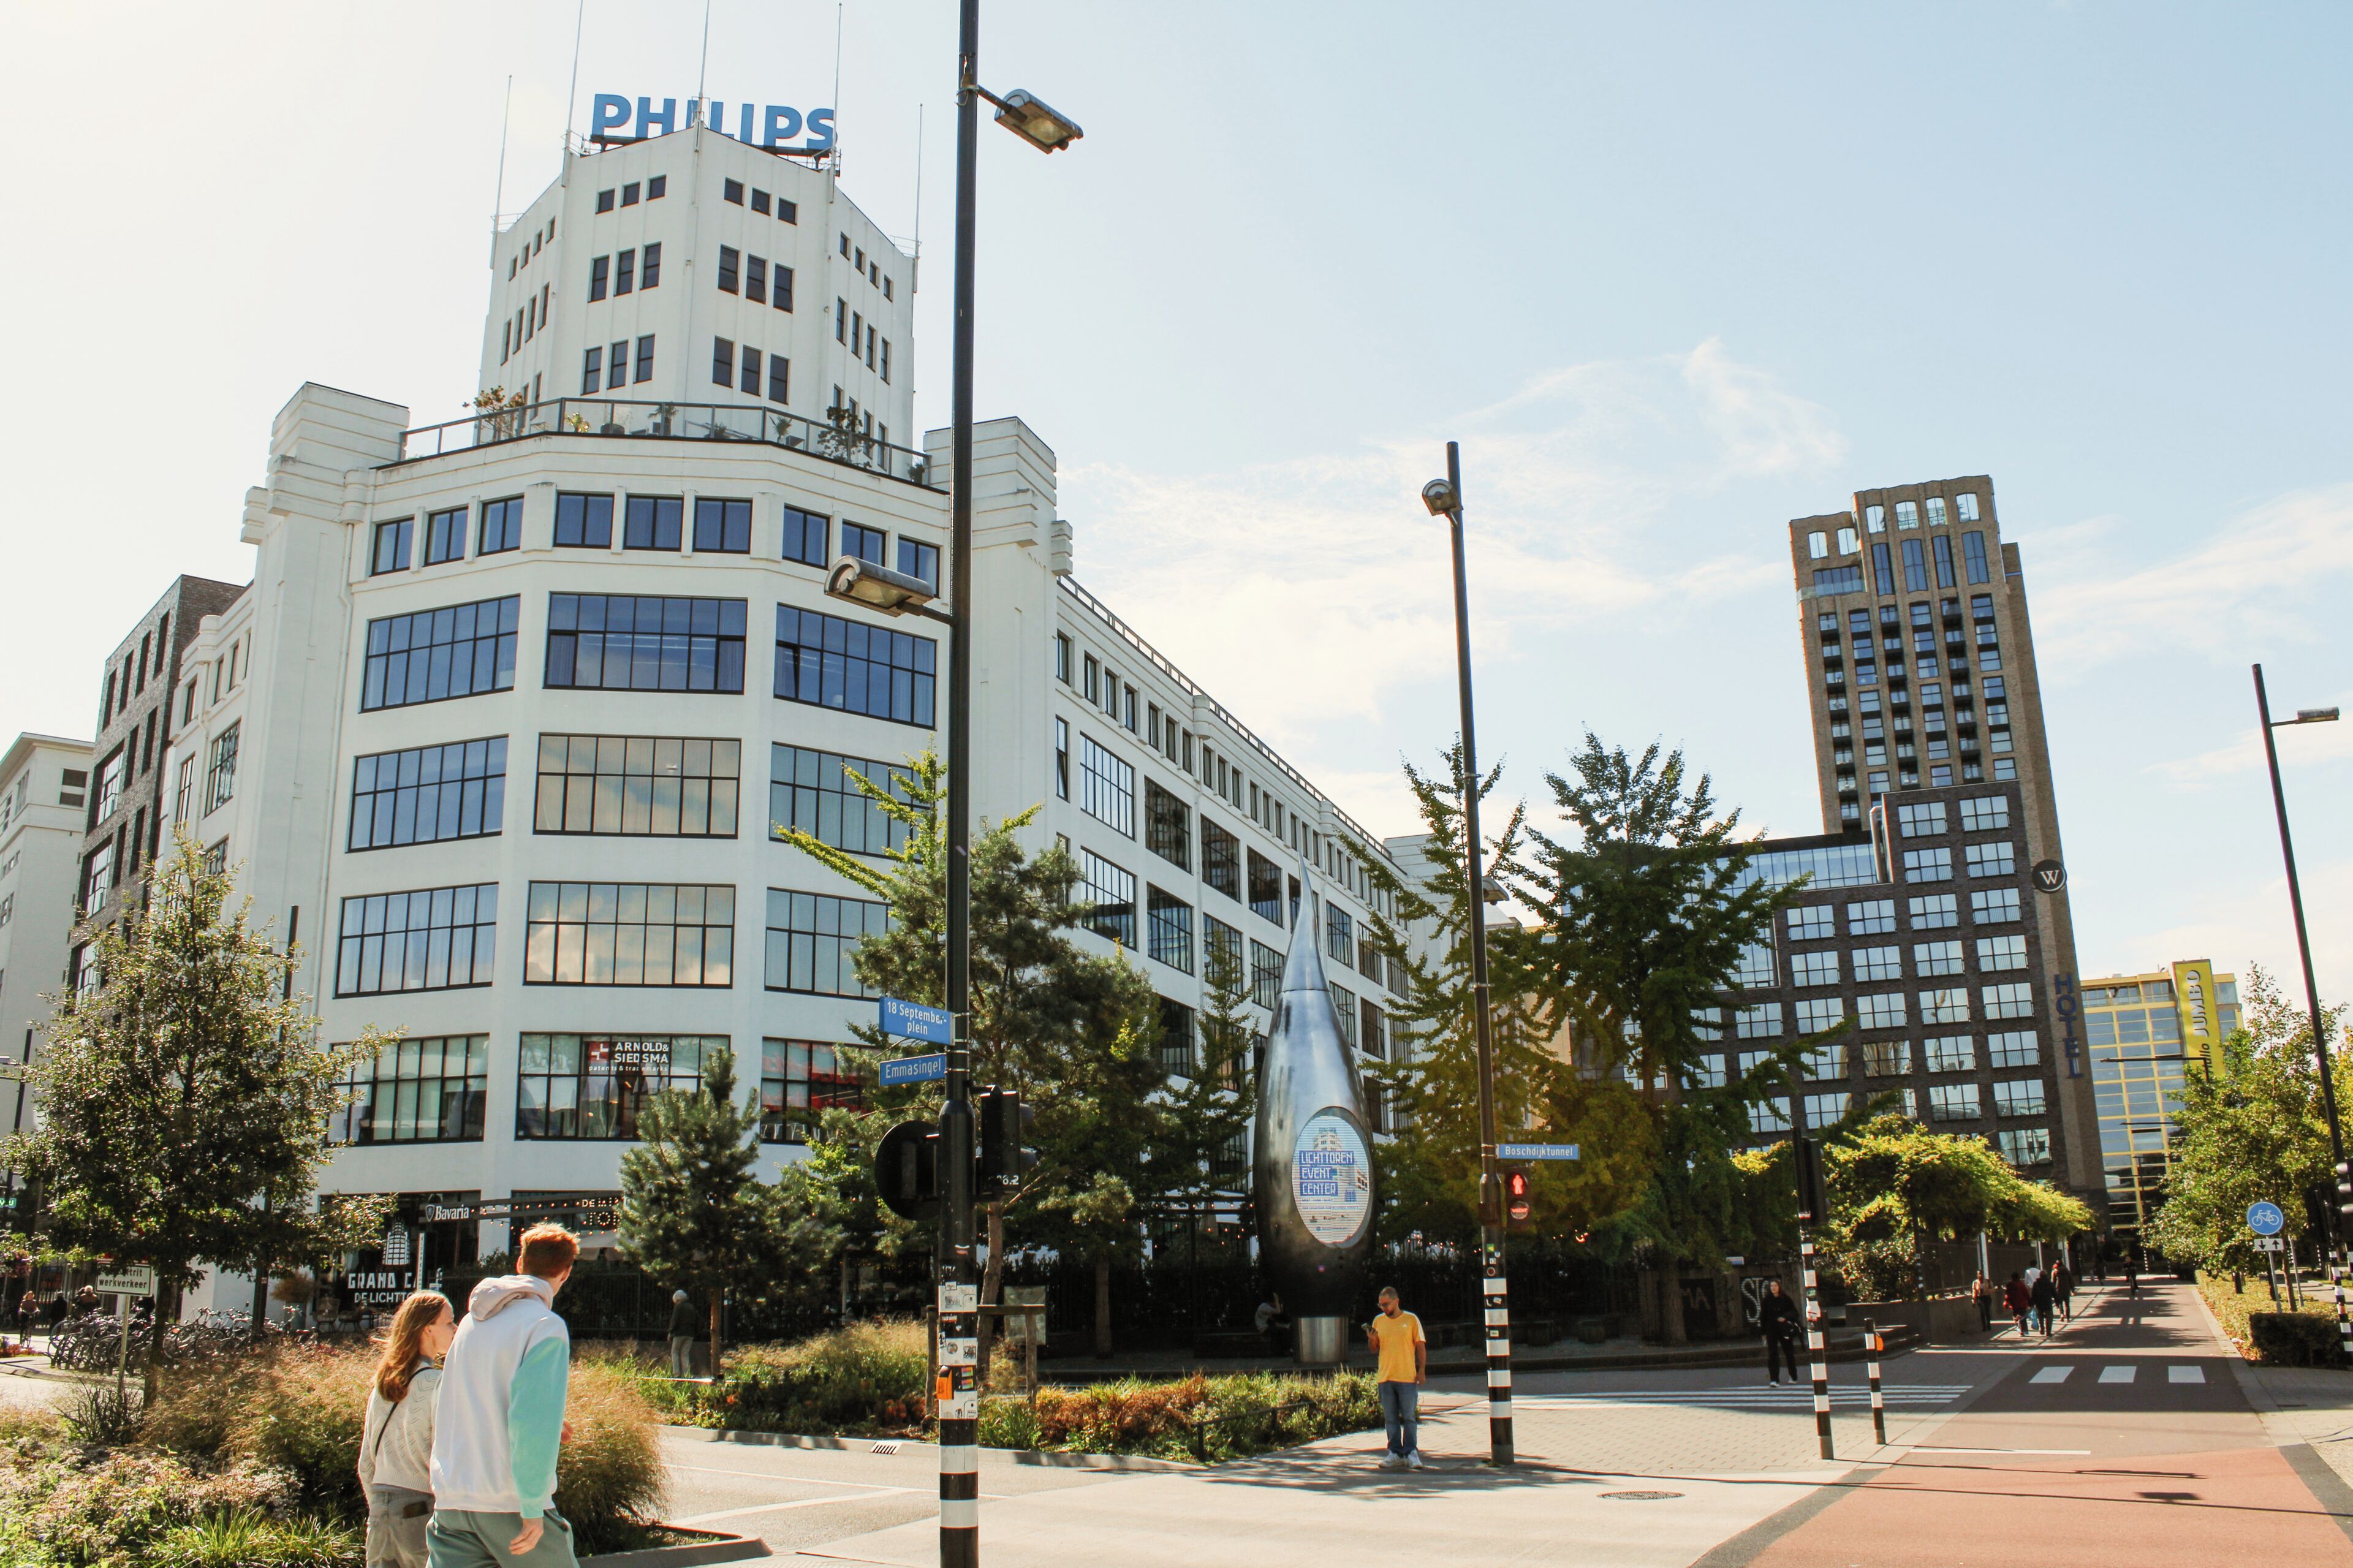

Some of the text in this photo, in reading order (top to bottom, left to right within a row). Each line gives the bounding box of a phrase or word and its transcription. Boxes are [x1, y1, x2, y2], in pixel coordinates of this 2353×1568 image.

[592, 94, 838, 149] PHILIPS
[2040, 869, 2059, 885] W
[887, 1001, 898, 1015] 18
[907, 1020, 928, 1036] plein
[2054, 973, 2085, 1079] HOTEL
[614, 1053, 669, 1063] SIEDSMA
[885, 1058, 942, 1079] Emmasingel
[1301, 1153, 1353, 1164] LICHTTOREN
[1505, 1146, 1573, 1158] Boschdijktunnel
[1302, 1168, 1331, 1180] EVENT
[1302, 1183, 1337, 1195] CENTER
[436, 1203, 469, 1221] Bavaria
[99, 1278, 147, 1289] werkverkeer
[347, 1272, 396, 1289] GRAND
